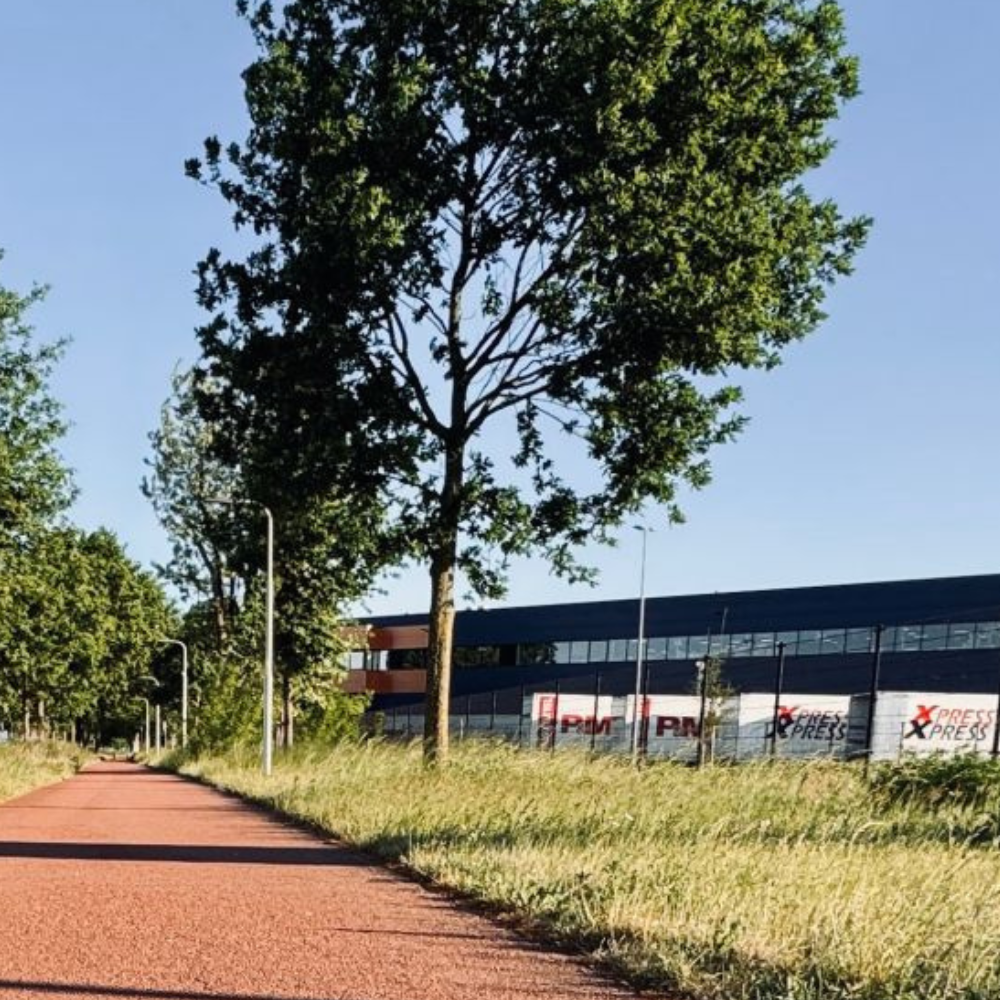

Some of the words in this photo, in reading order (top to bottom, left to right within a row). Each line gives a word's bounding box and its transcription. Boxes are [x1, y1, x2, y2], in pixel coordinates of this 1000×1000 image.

[778, 705, 850, 724] XPRES
[916, 705, 995, 724] XPRESS
[904, 720, 988, 741] XPRESS
